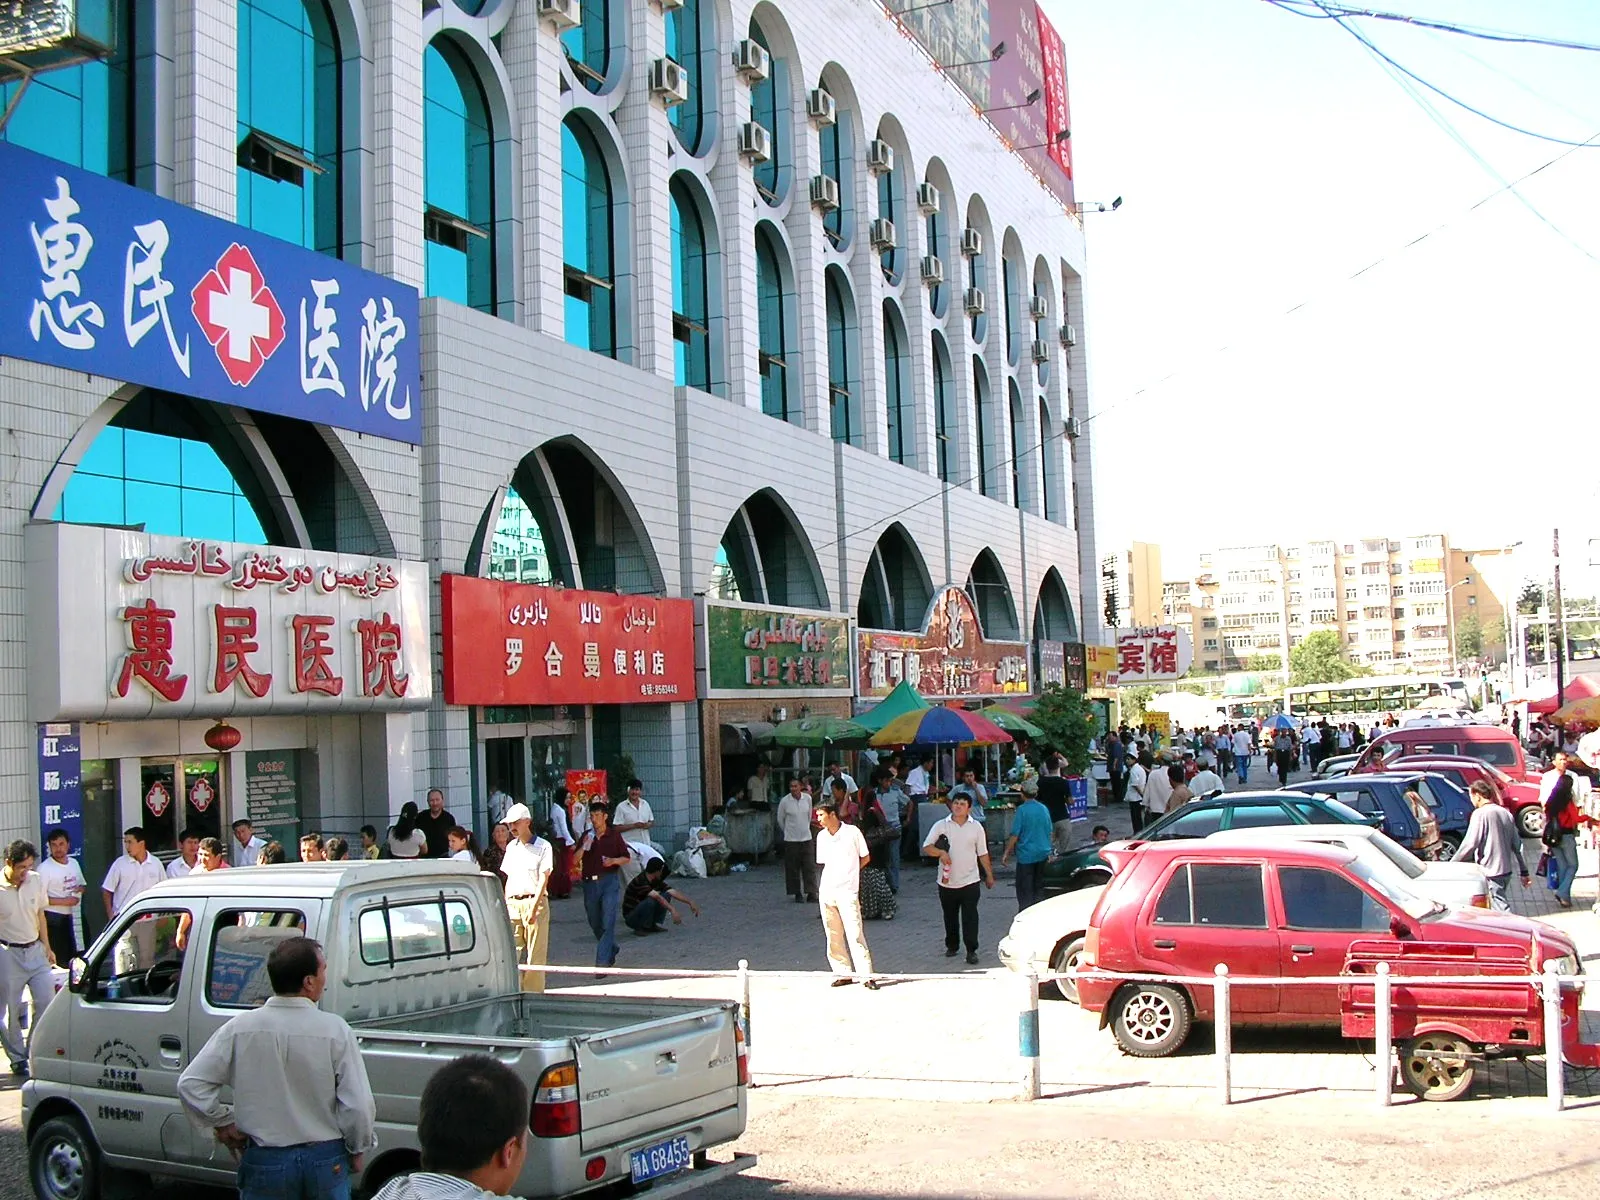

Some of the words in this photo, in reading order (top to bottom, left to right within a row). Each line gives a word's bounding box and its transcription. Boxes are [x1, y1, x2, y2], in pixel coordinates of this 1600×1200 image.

[112, 597, 410, 703] 惠民医院
[504, 637, 666, 680] 罗合曼便利店
[1118, 642, 1178, 675] 宾馆
[650, 1140, 689, 1172] G8455
